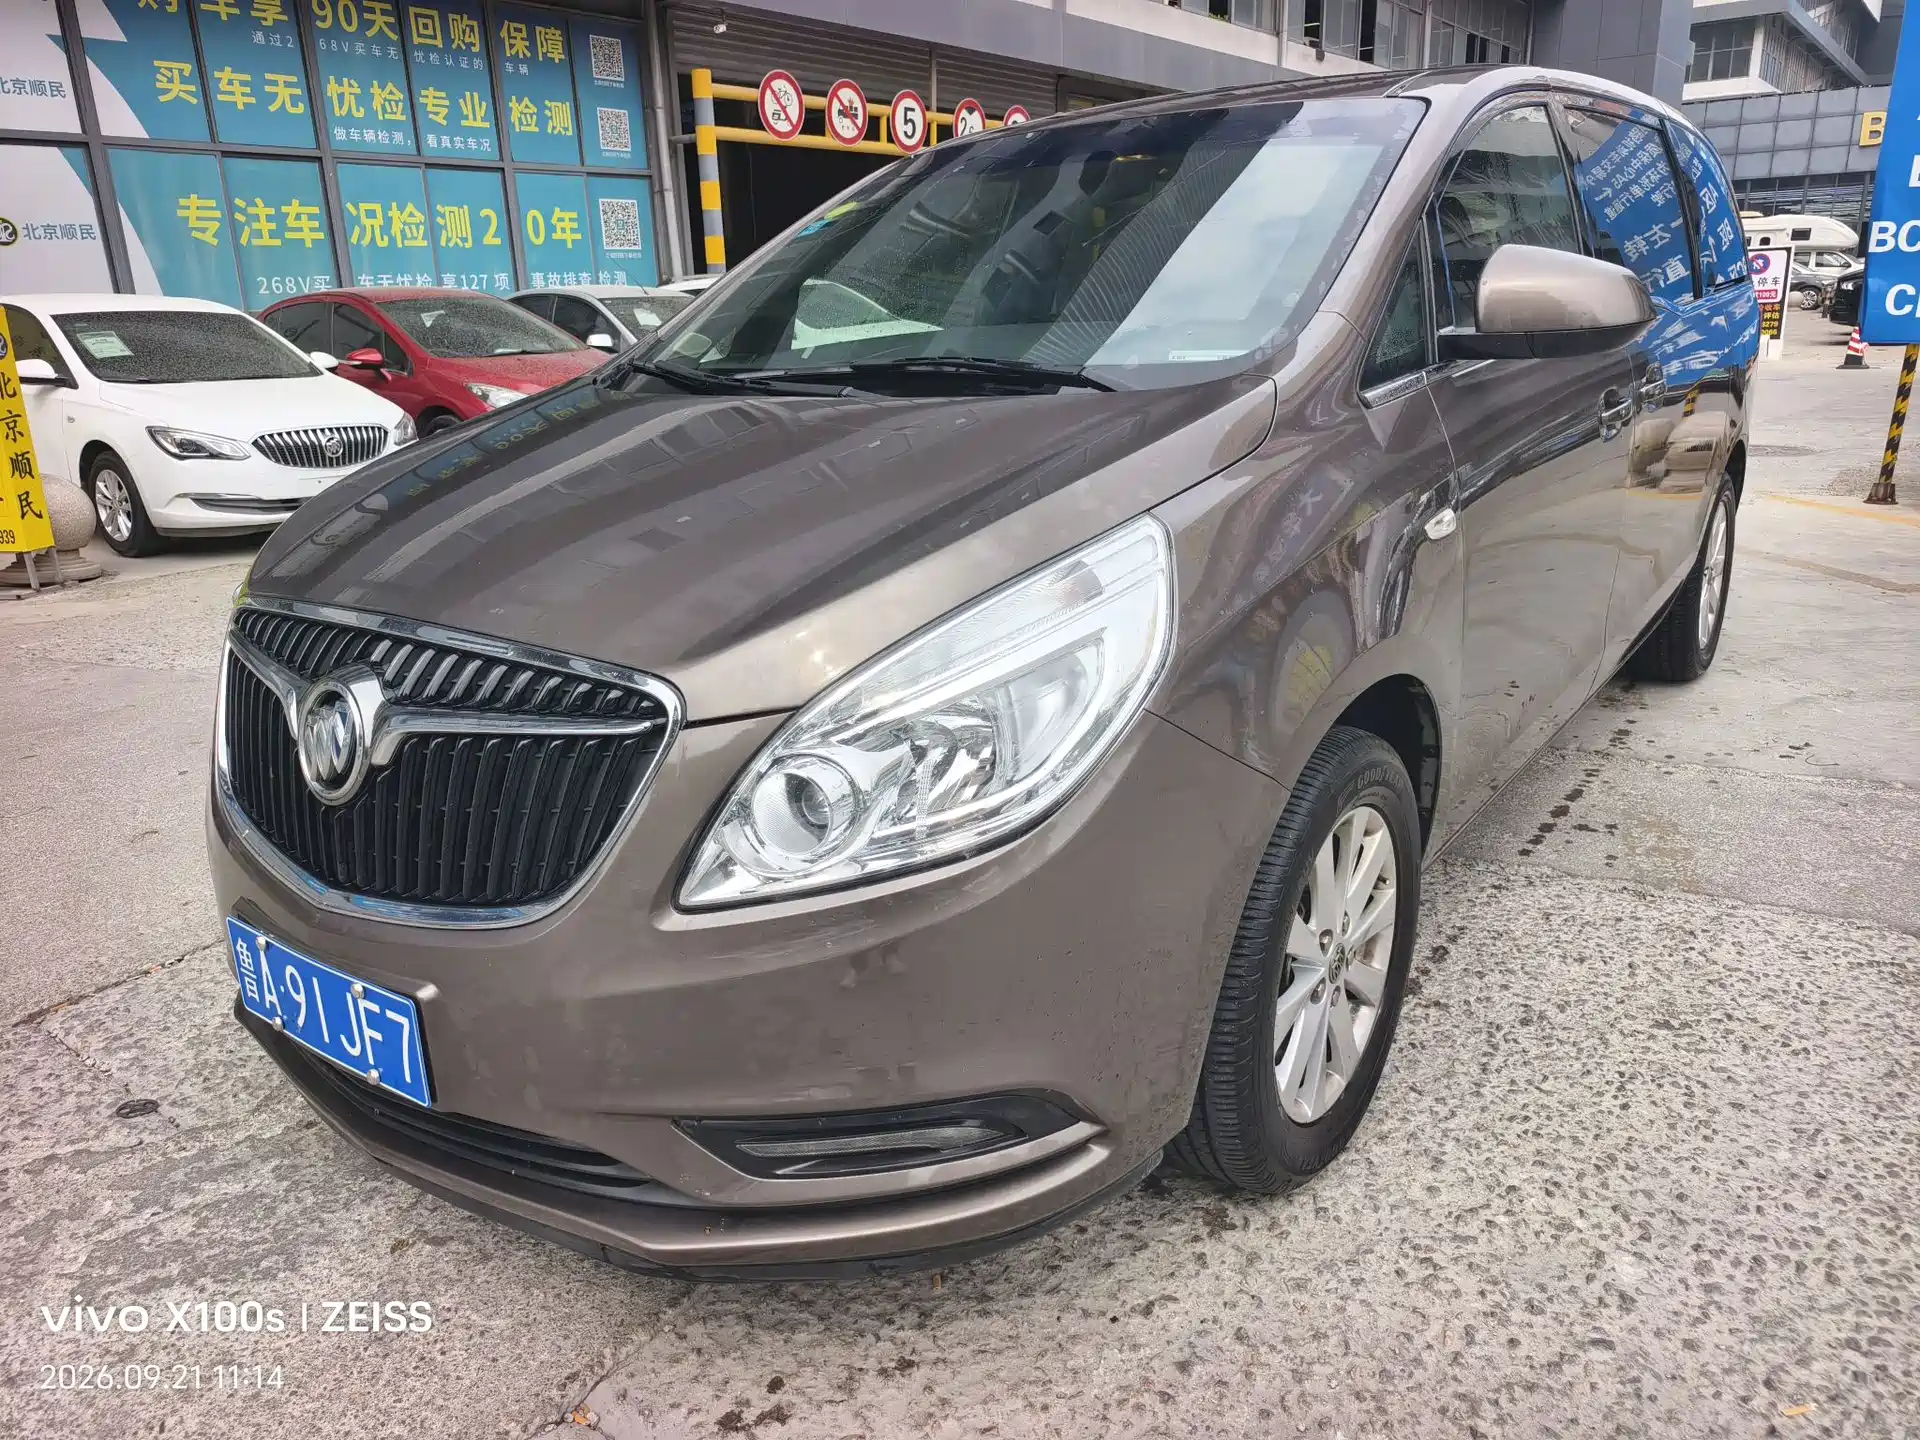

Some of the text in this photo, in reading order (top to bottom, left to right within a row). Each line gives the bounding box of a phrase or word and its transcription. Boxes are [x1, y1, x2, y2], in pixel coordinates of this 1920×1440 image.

[902, 107, 916, 140] 5
[22, 222, 97, 241] 北京顺民
[176, 194, 583, 249] 专注车况检测20年
